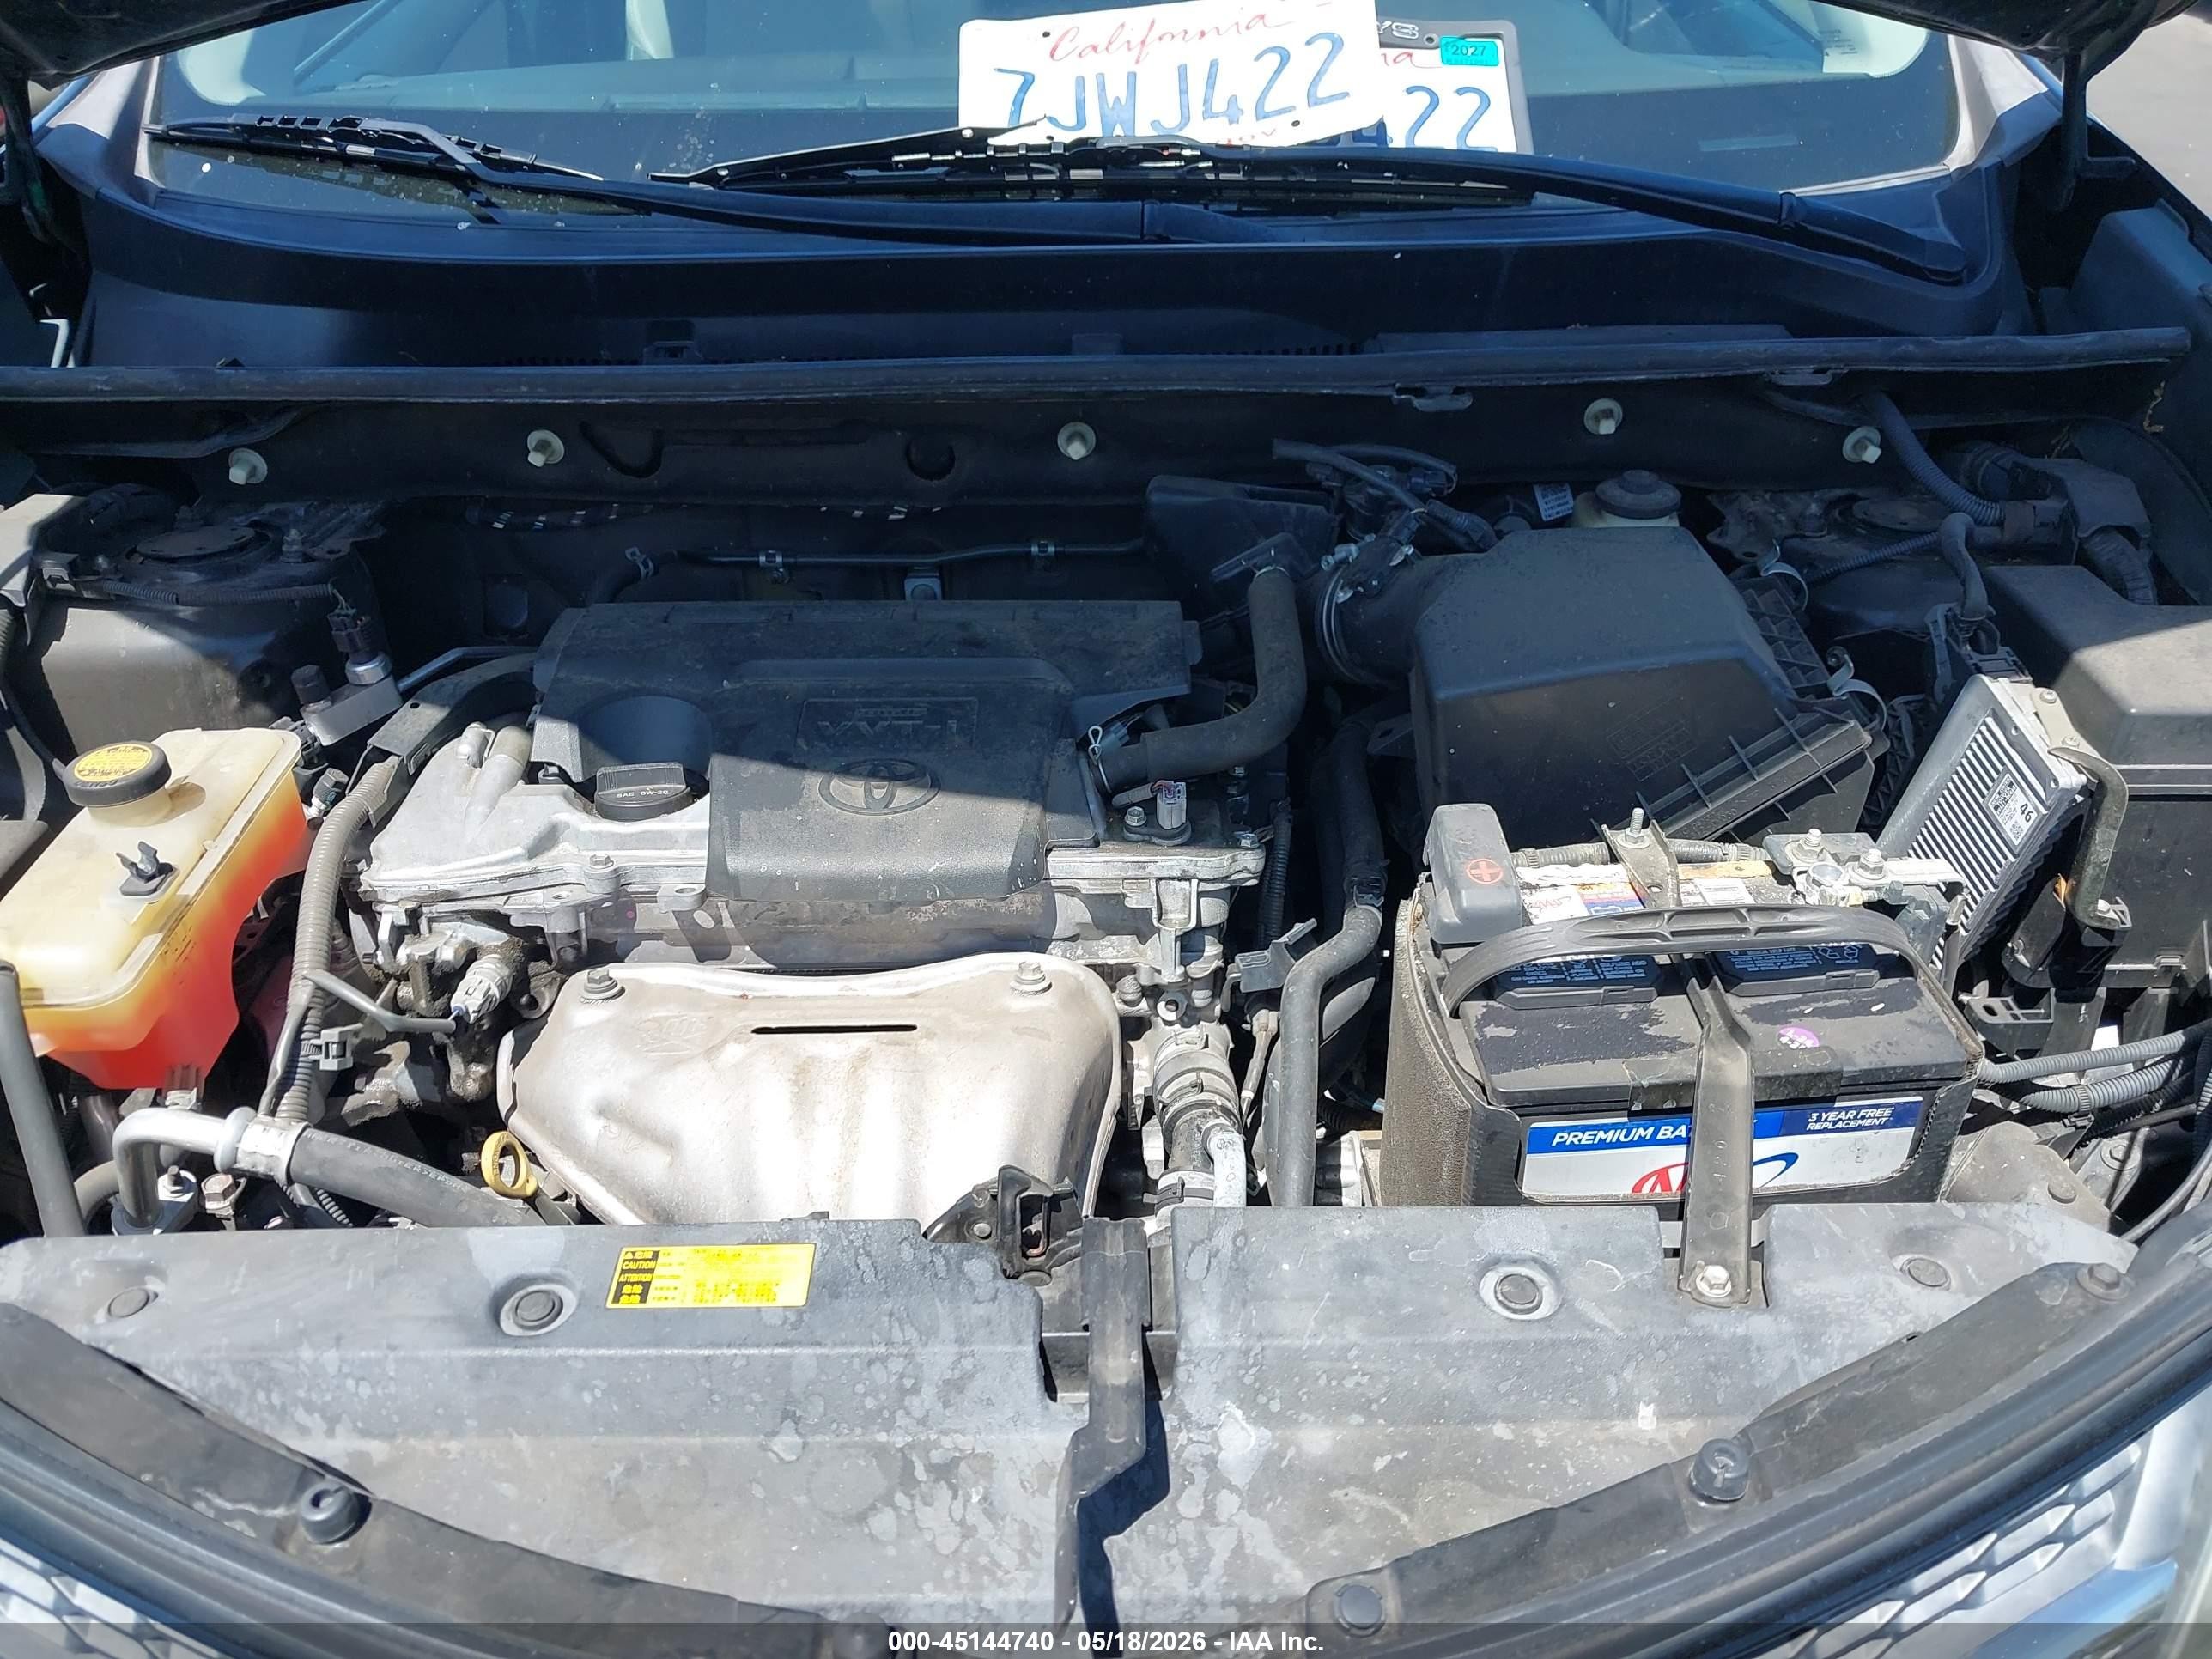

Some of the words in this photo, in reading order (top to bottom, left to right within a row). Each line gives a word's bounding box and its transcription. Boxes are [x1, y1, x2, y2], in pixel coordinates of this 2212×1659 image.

[1049, 14, 1295, 65] California
[1451, 44, 1486, 56] 2027
[994, 32, 1349, 137] 7JWJ422
[1389, 85, 1498, 152] 22
[640, 788, 670, 797] 0W-20
[2020, 803, 2034, 823] 46
[1808, 1113, 1820, 1122] 3
[1820, 1109, 1856, 1121] YEAR
[1857, 1107, 1895, 1119] FREE
[1552, 1127, 1654, 1146] PREMIUM
[1656, 1124, 1694, 1140] BA
[623, 1260, 657, 1270] CAUTION
[617, 1273, 653, 1282] ATTENTION
